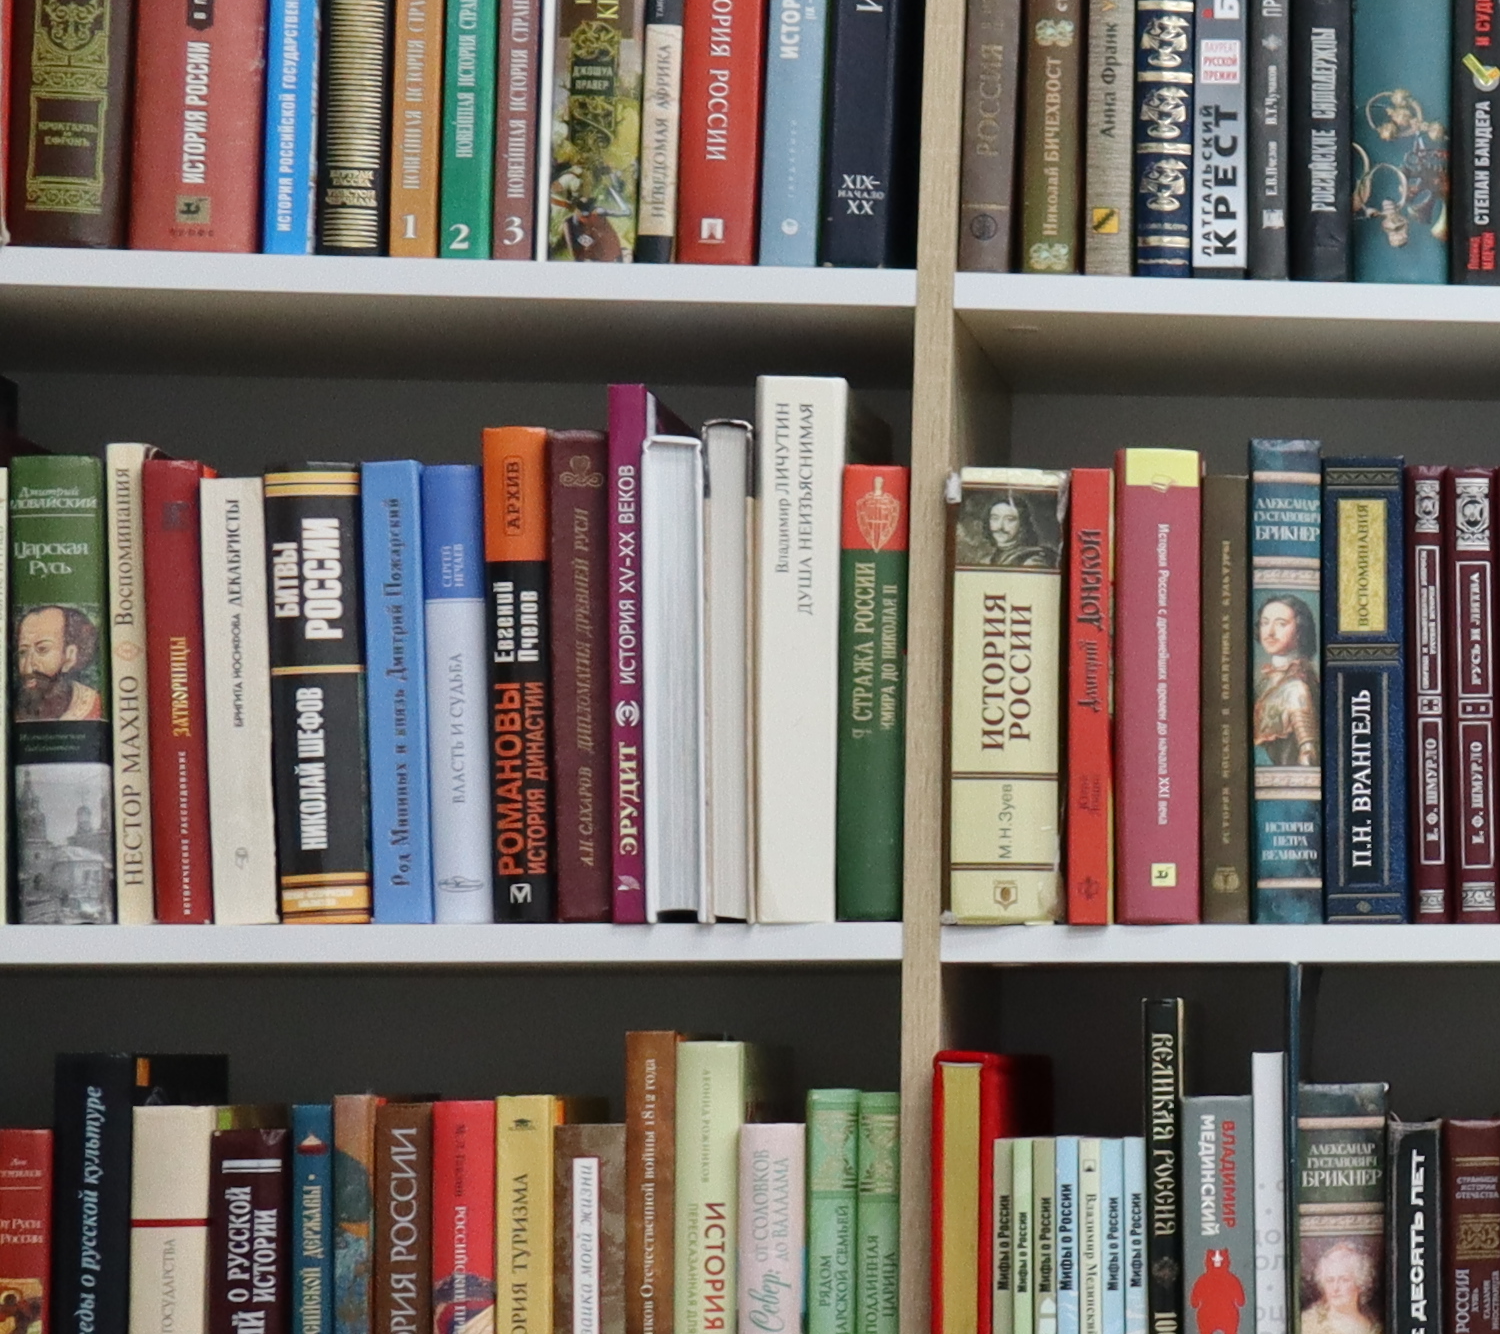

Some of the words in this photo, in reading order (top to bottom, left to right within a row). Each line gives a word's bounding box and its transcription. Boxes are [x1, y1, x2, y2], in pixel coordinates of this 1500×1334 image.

[1200, 105, 1213, 258] ЛАТГАЛЬСКИЙ
[1214, 105, 1238, 257] КРЕСТ
[274, 542, 300, 618] БИТВЫ
[301, 517, 343, 639] РОССИИ
[297, 687, 326, 758] ШЕФОВ
[981, 592, 1007, 751] ИСТОРИЯ
[1009, 604, 1033, 741] РОССИИ
[297, 762, 328, 850] НИКОЛАЙ
[495, 682, 525, 877] РОМАНОВЫ
[1351, 690, 1372, 812] ВРАНГЕЛЬ
[1353, 820, 1373, 867] П.Н.
